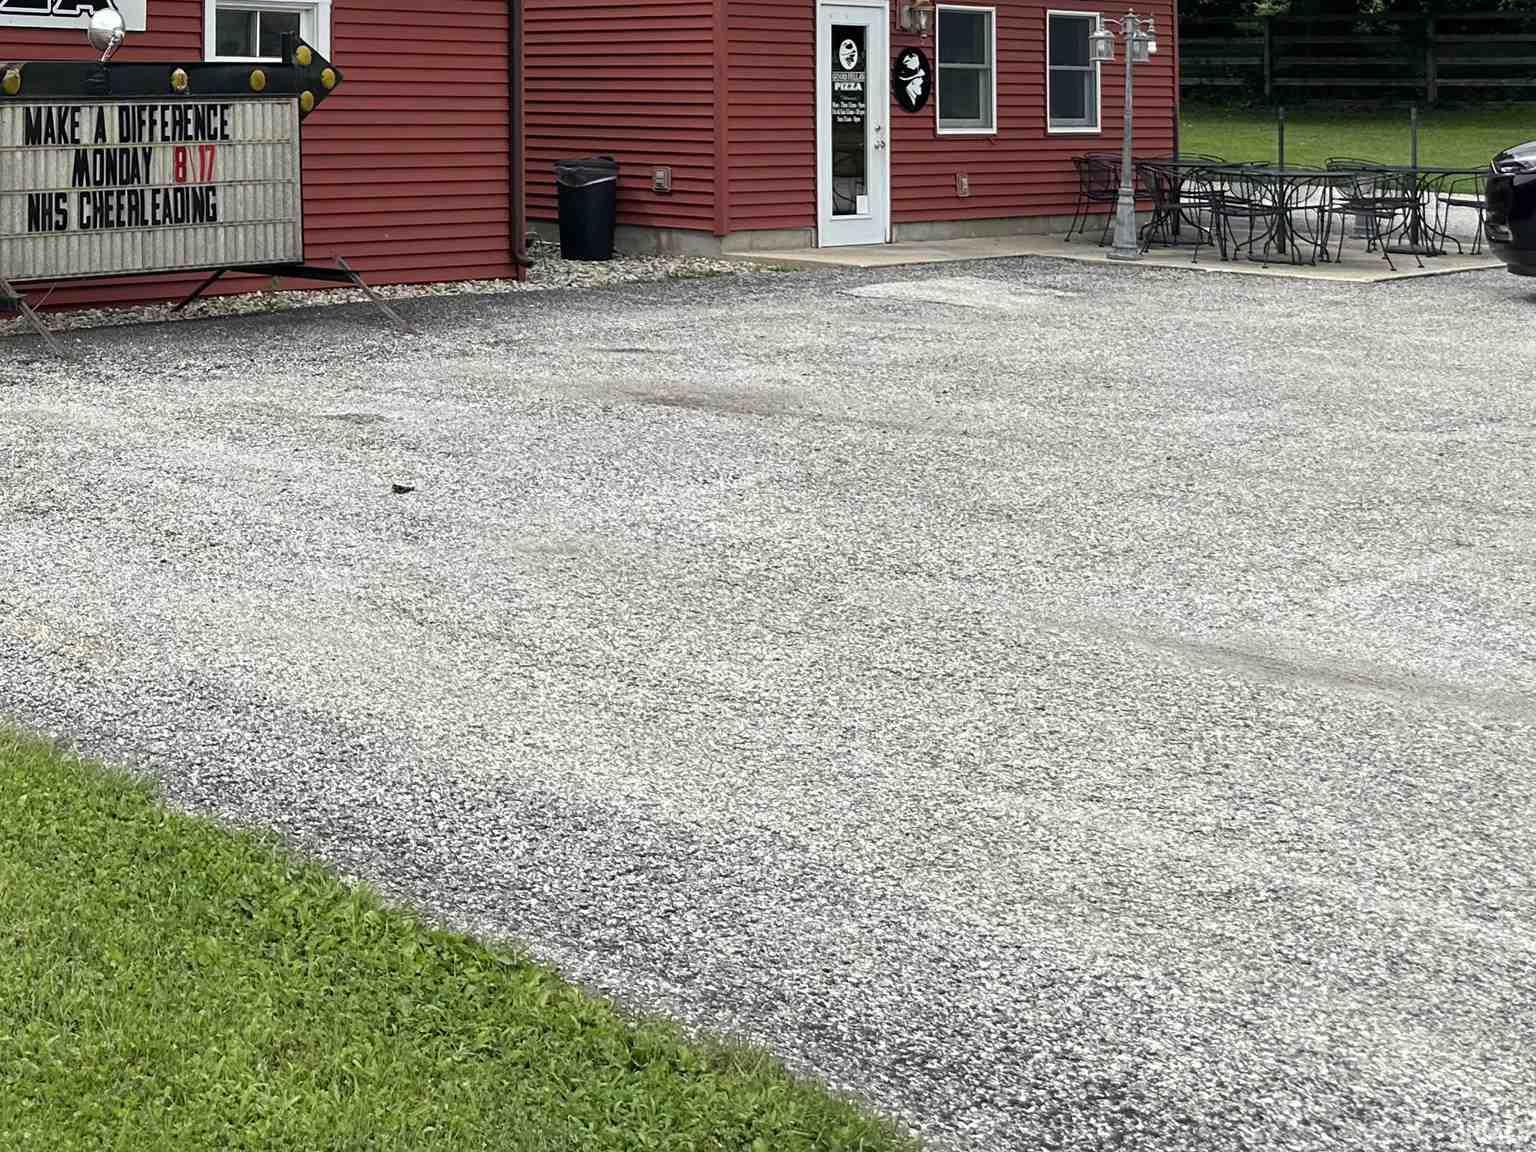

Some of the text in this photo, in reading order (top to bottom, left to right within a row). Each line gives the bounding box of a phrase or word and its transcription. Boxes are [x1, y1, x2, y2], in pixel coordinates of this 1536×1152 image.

[834, 82, 863, 91] PIZZA
[24, 103, 231, 146] MAKE A DIFFERENCE
[72, 147, 153, 187] MONDAY
[27, 186, 218, 233] NHS CHEERLEADING
